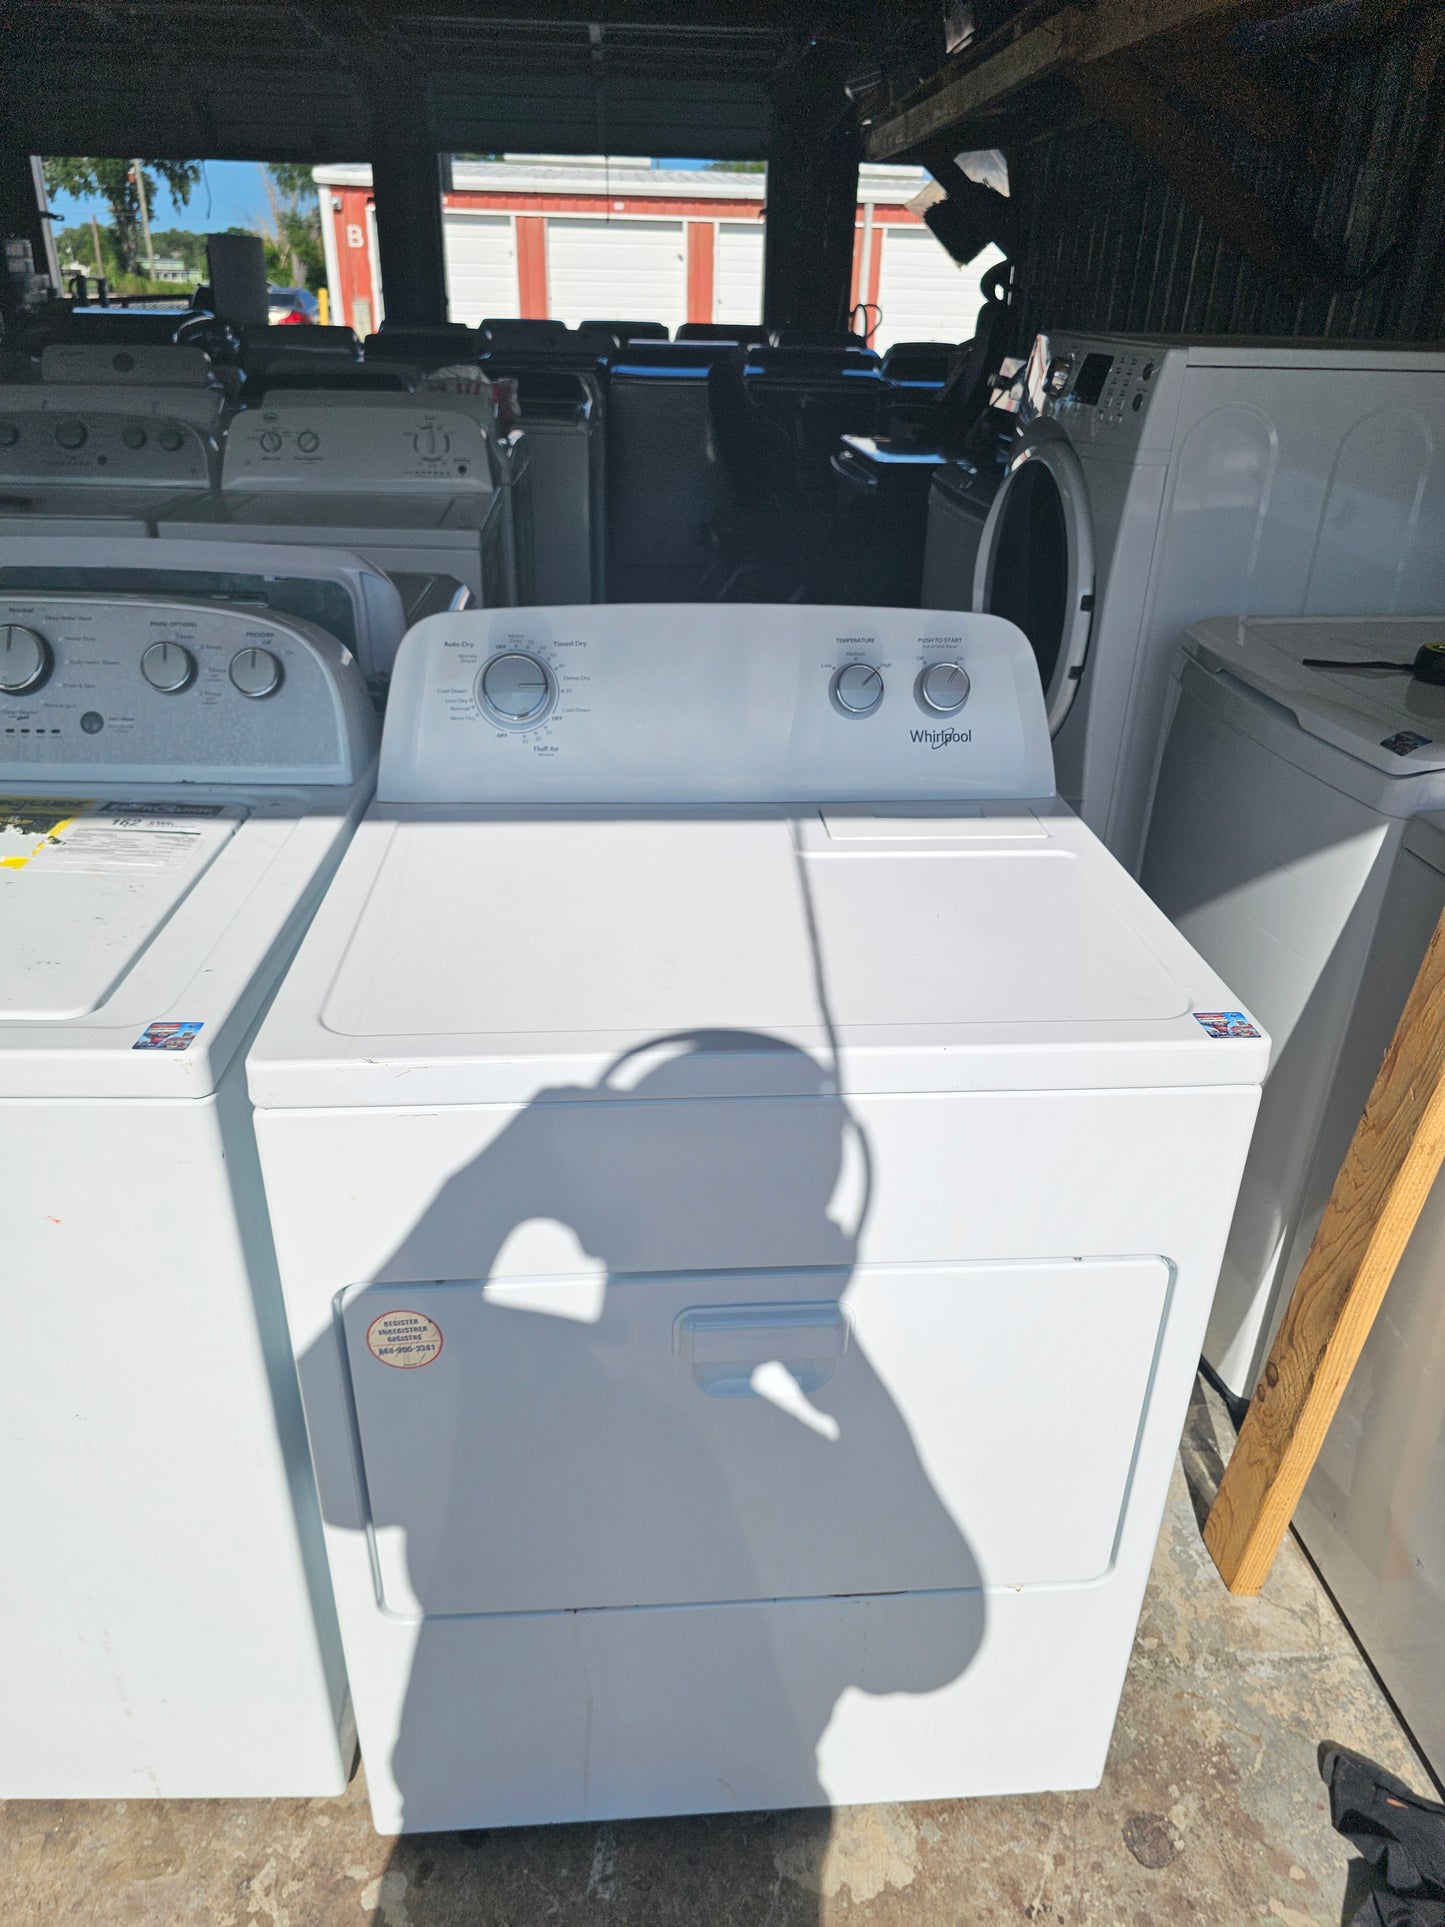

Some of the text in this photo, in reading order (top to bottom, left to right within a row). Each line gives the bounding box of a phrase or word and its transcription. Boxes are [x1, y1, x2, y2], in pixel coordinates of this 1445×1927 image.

[346, 224, 364, 248] B
[461, 641, 474, 649] Dry
[553, 640, 587, 648] Timed Dry
[909, 727, 972, 750] Whirlpool
[383, 1318, 419, 1328] REGISTER
